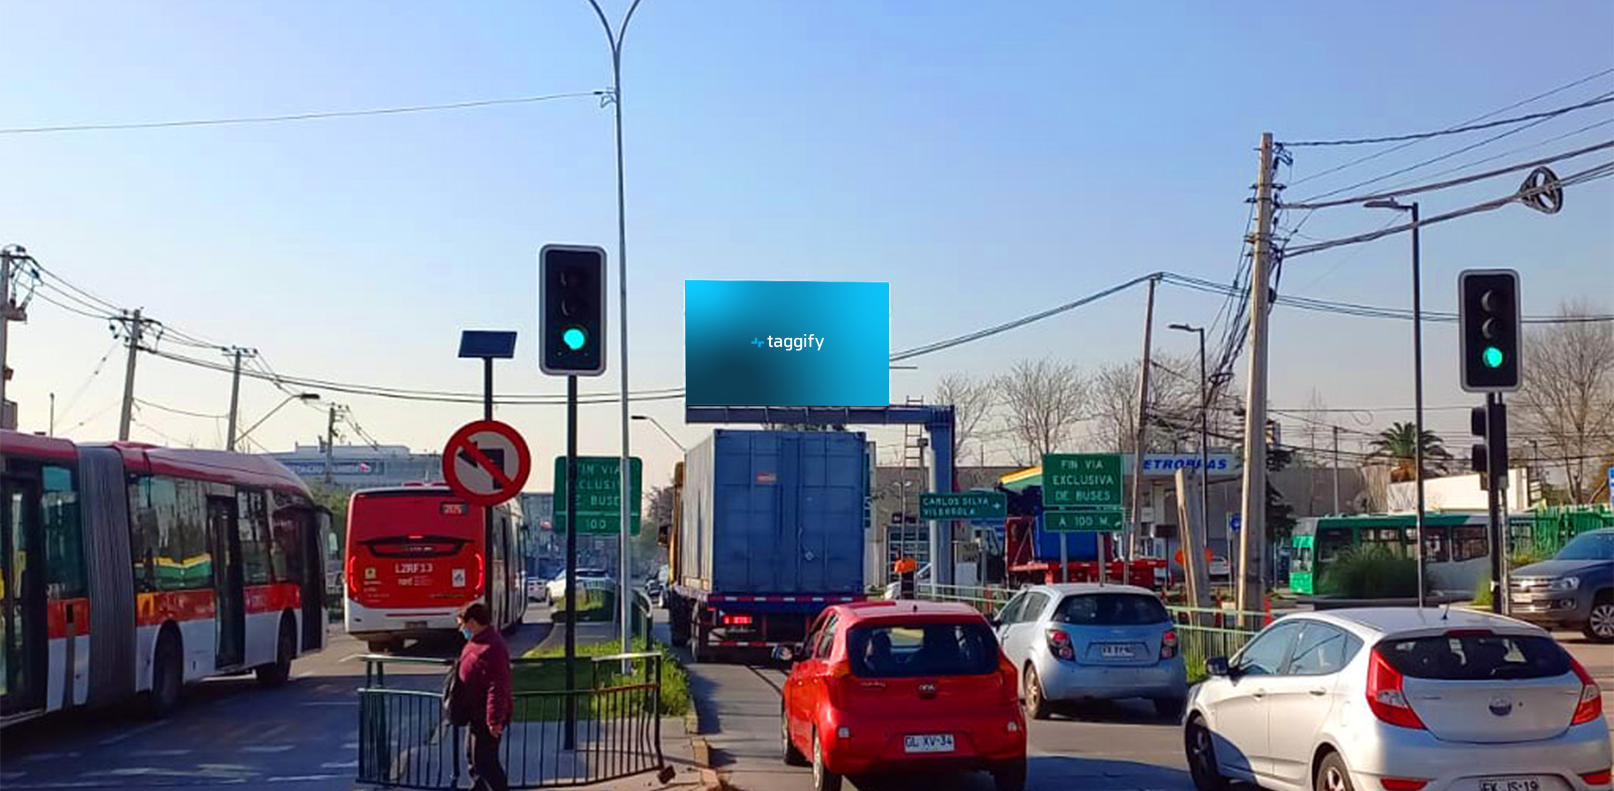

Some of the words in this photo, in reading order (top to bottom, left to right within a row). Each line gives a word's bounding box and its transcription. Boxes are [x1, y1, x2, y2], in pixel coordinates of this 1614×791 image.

[767, 333, 825, 351] taggify
[1061, 460, 1078, 469] FIN
[1085, 460, 1103, 469] VIA
[1053, 475, 1113, 485] EXCLUSIVA
[1056, 491, 1069, 501] DE
[1076, 490, 1110, 501] BUSES
[923, 498, 960, 506] CARLOS
[962, 497, 989, 506] SILVA
[1059, 516, 1067, 527] A
[1075, 516, 1094, 526] 100
